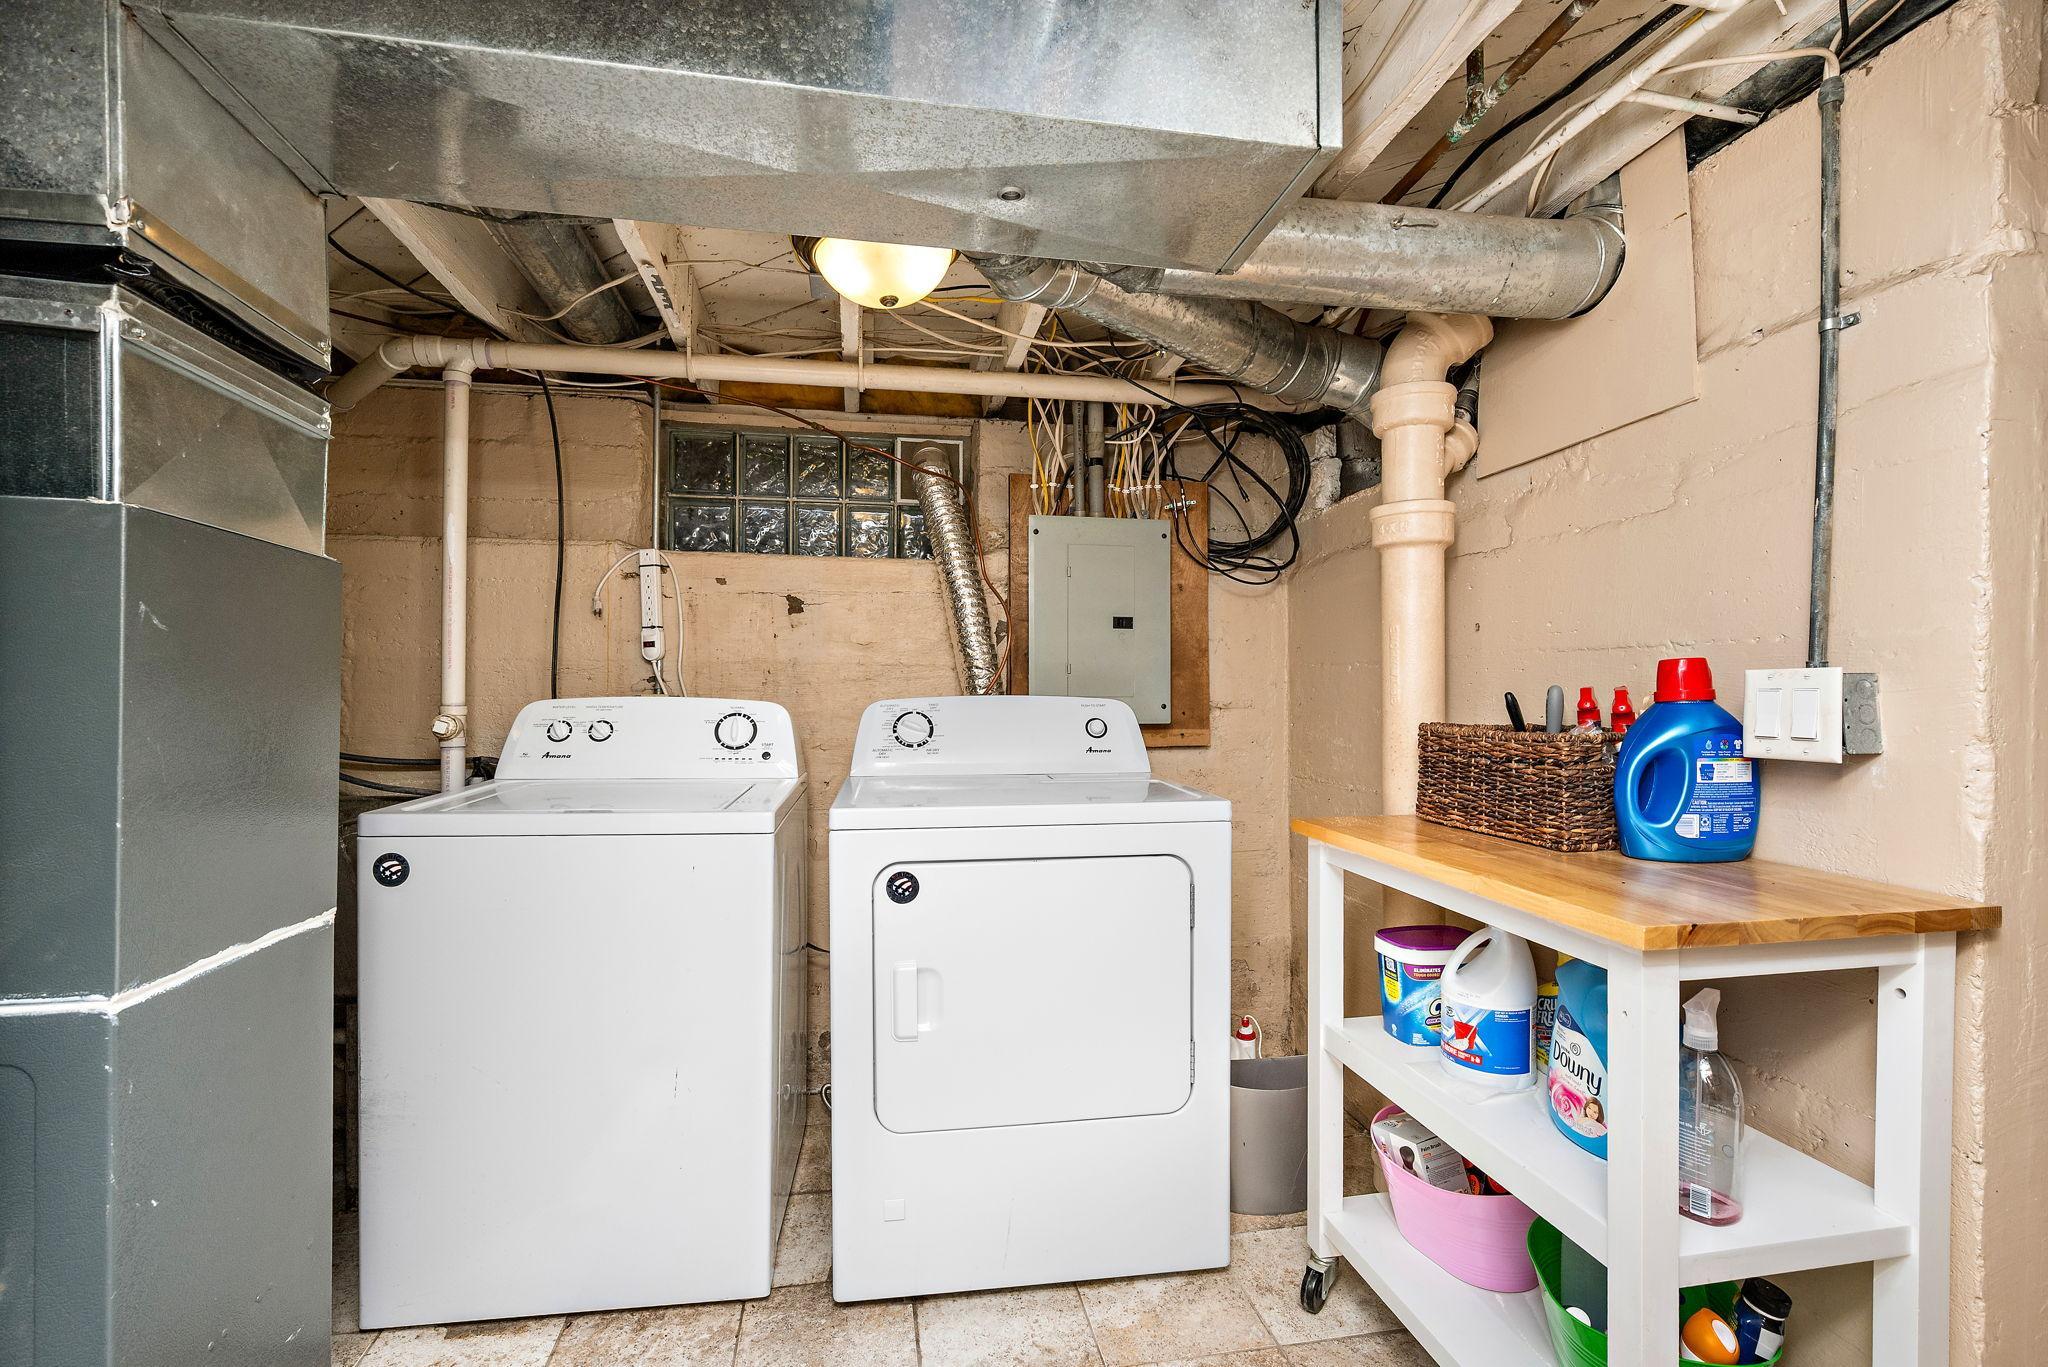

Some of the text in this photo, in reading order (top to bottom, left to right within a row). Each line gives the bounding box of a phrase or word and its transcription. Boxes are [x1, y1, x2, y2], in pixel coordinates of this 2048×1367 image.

[1086, 746, 1111, 754] Amana
[541, 751, 571, 759] Amana
[1553, 1039, 1603, 1097] Downy
[1430, 1142, 1442, 1150] Brush
